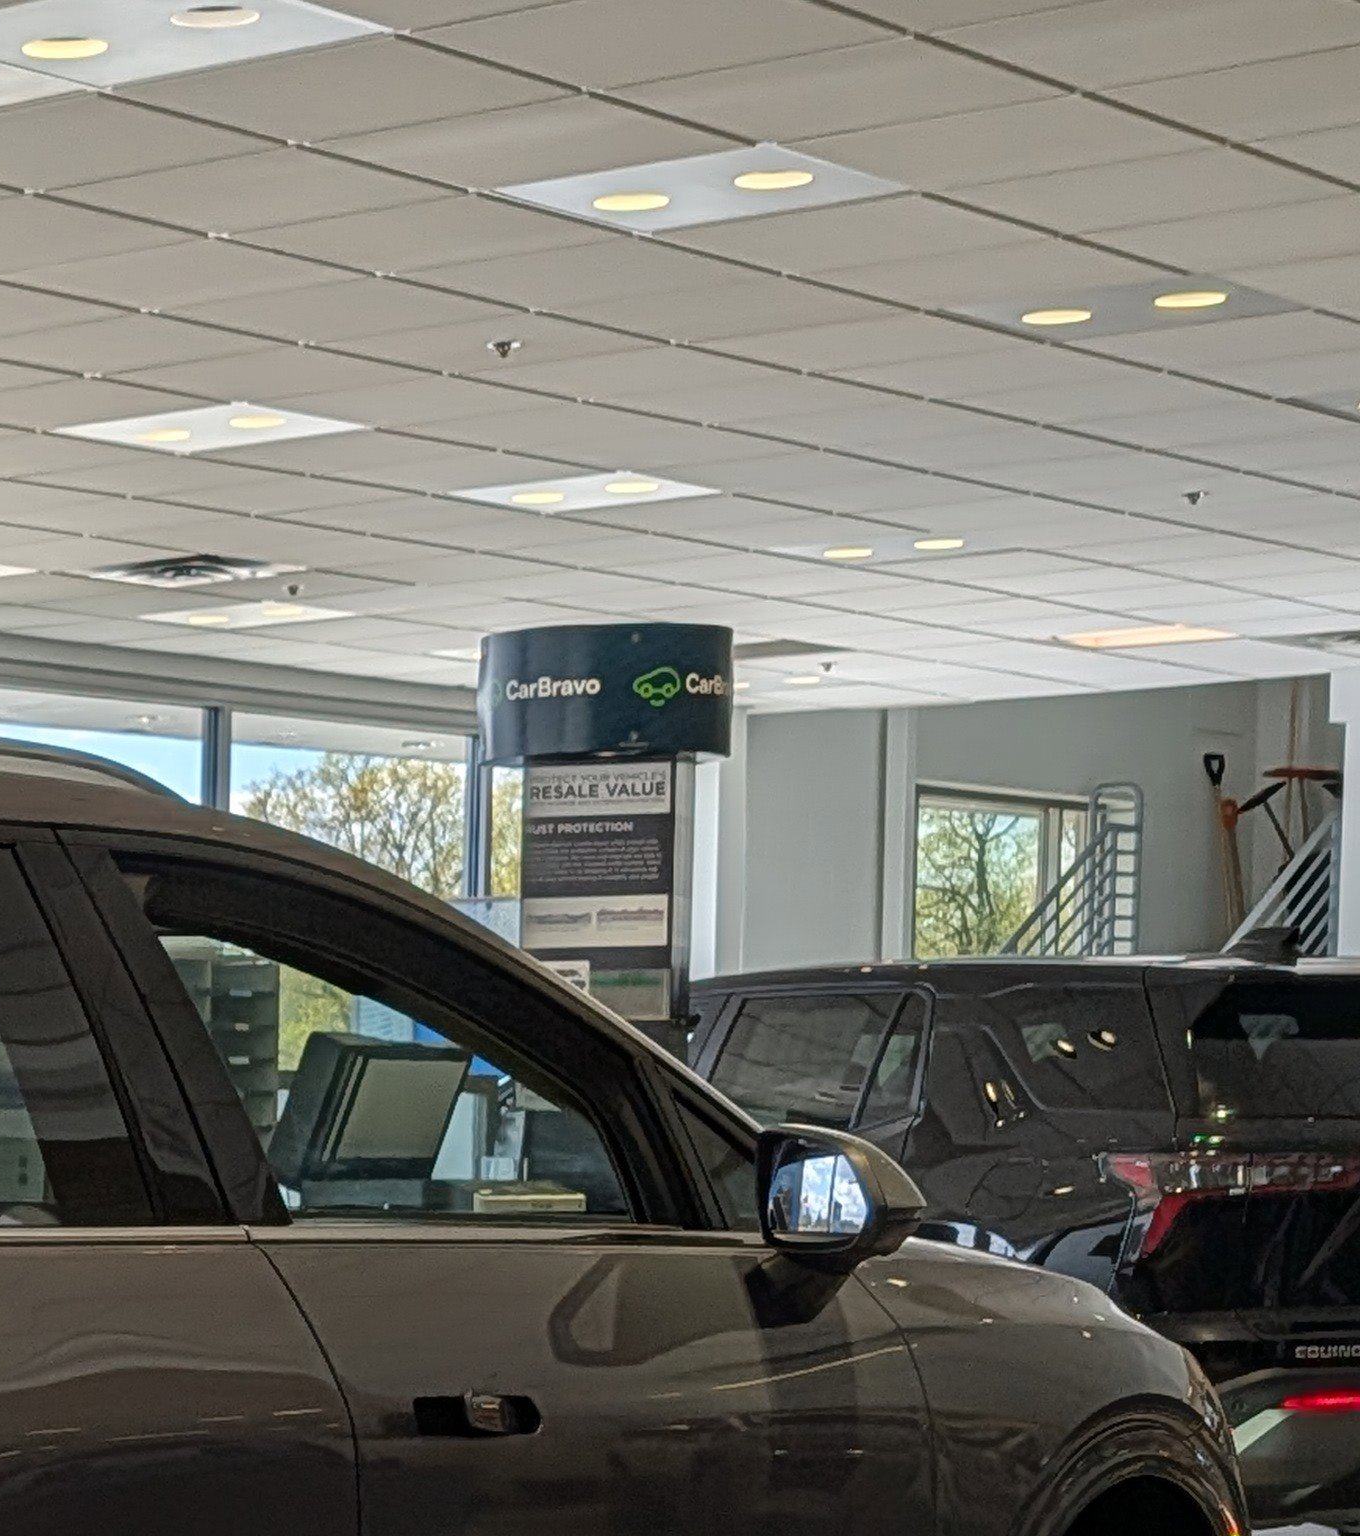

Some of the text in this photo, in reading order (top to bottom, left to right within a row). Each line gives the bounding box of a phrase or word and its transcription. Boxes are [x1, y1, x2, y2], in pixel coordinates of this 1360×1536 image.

[505, 675, 602, 700] CarBravo
[530, 781, 667, 800] RESALE VALUE
[558, 821, 634, 834] PROTECTION
